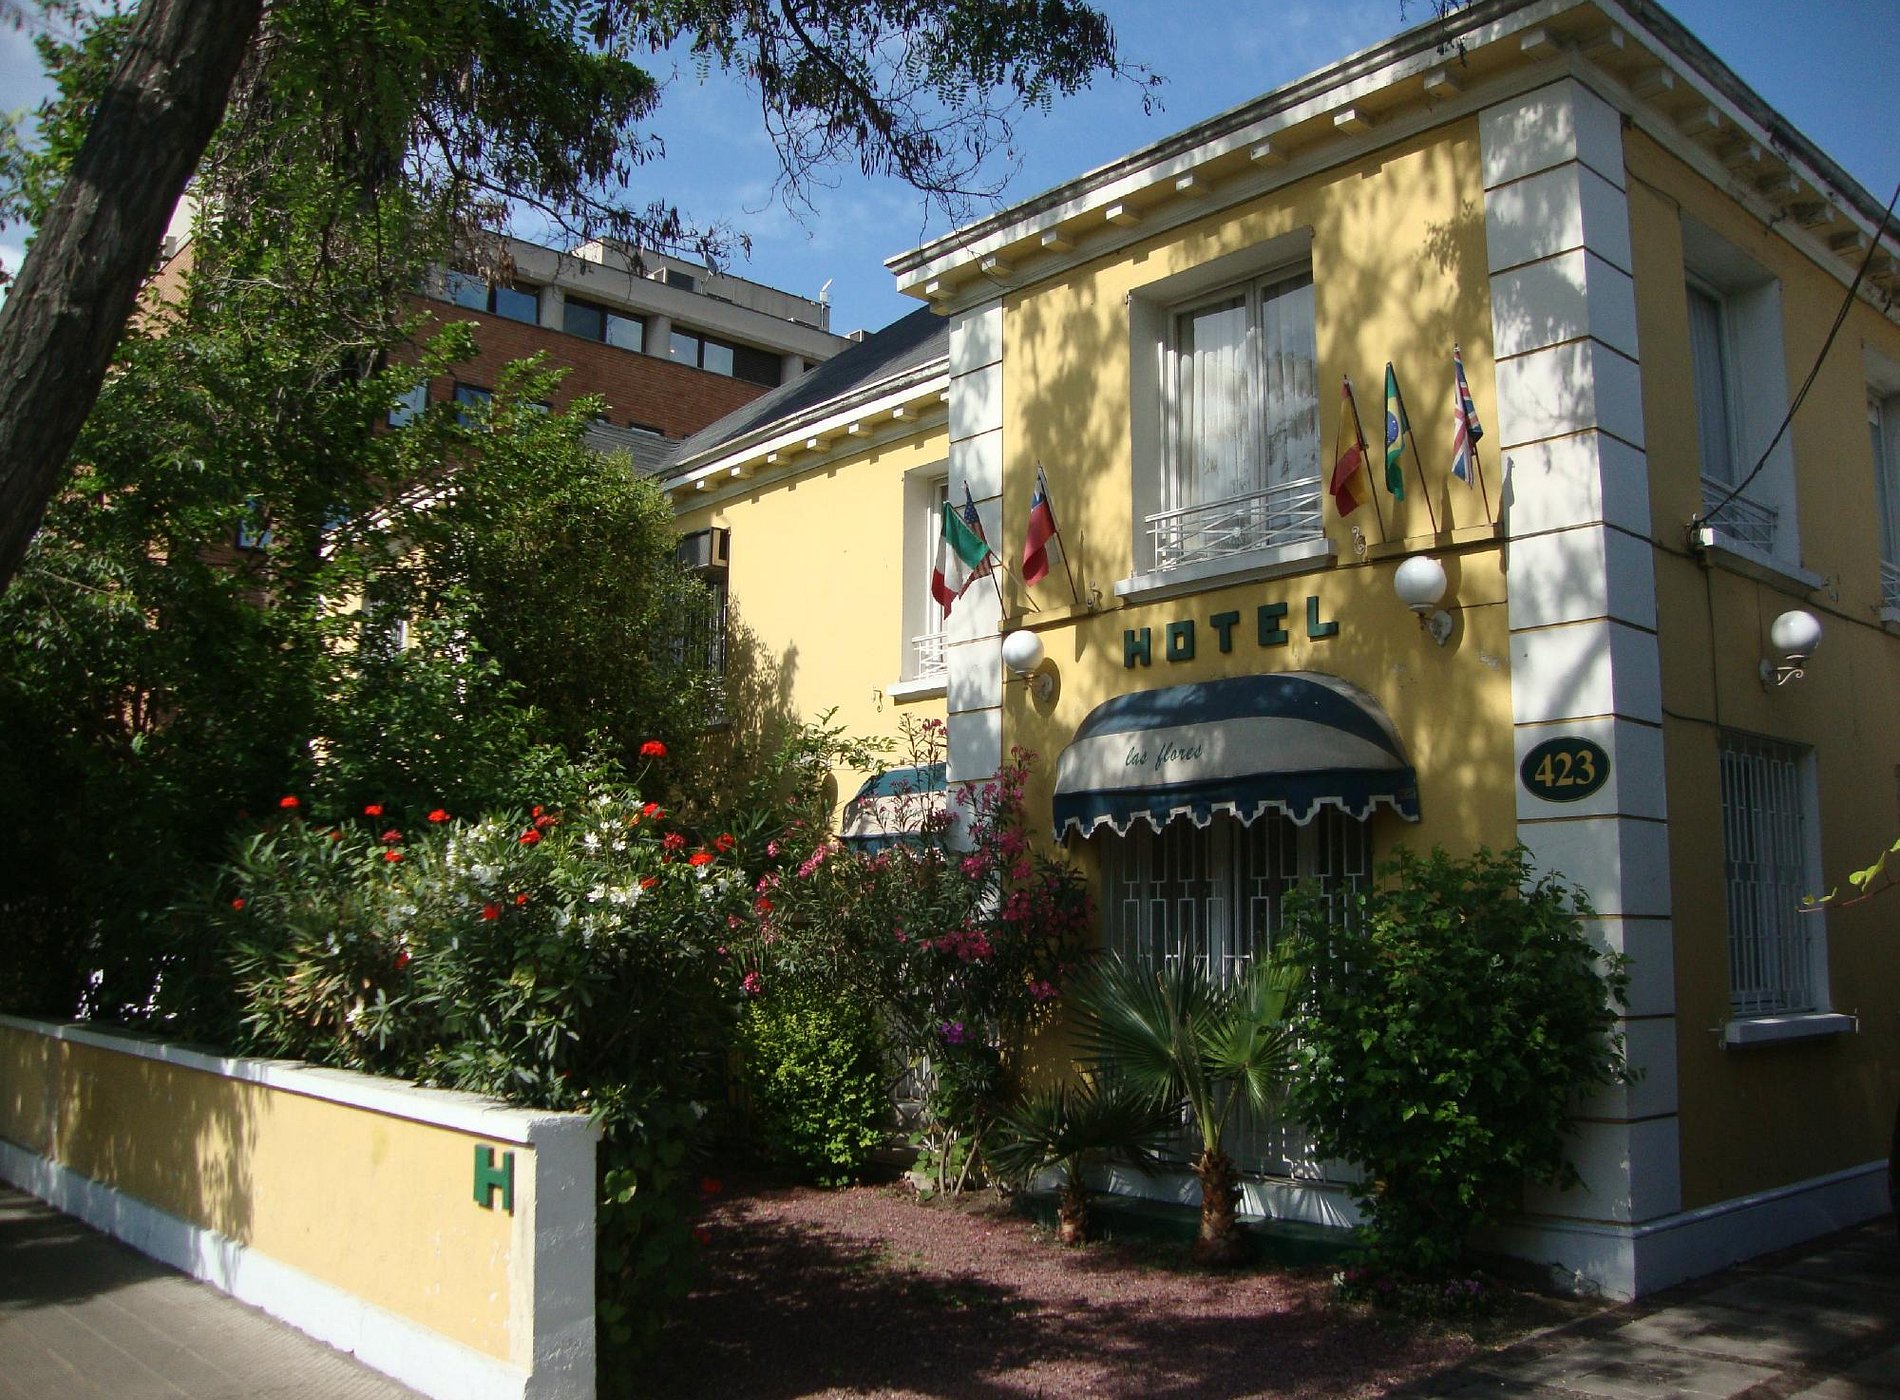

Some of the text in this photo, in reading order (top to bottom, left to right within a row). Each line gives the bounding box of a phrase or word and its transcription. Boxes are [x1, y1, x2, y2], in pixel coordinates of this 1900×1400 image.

[1124, 596, 1339, 668] HOTEL
[1535, 750, 1595, 787] 423
[474, 1145, 513, 1211] H
